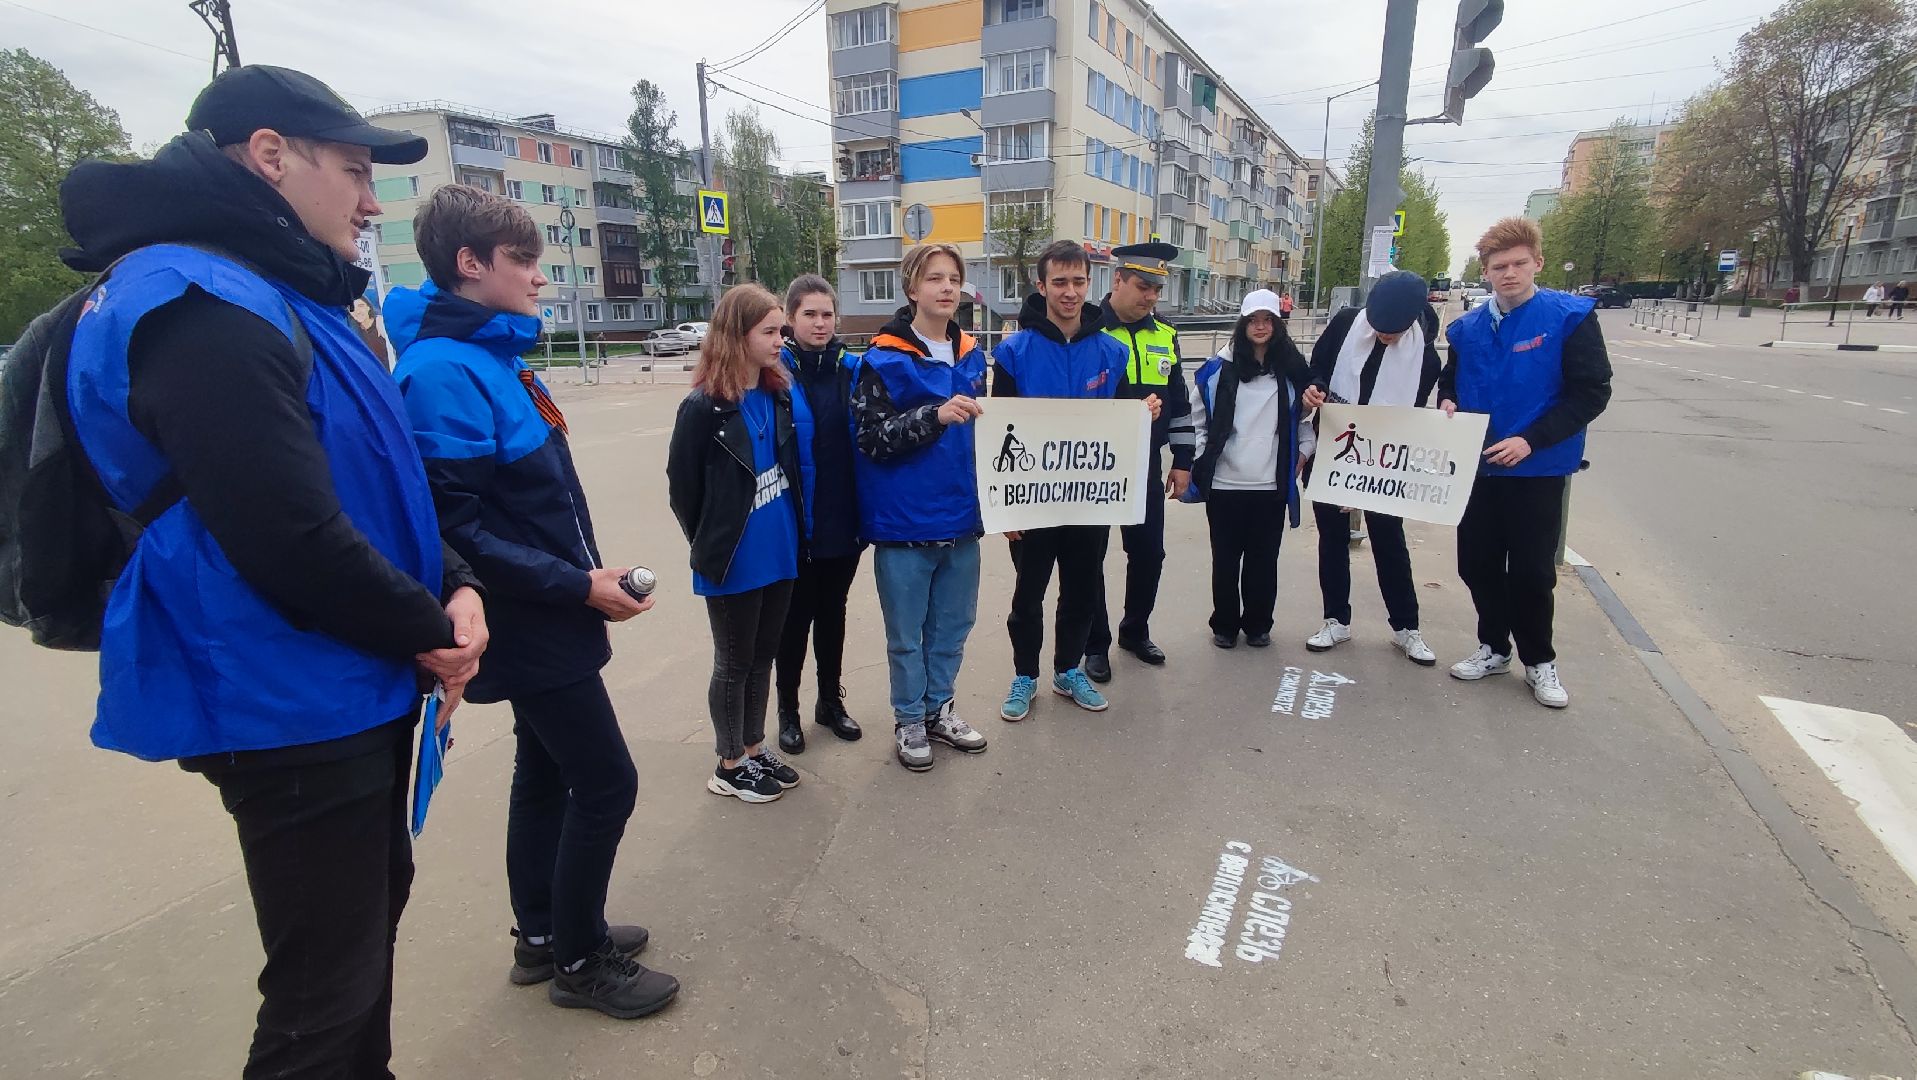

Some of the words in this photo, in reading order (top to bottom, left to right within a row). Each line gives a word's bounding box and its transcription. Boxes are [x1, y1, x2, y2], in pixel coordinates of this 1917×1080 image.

[1004, 477, 1128, 506] велосипеда!
[1328, 471, 1341, 487] с
[1344, 472, 1453, 505] самоката!
